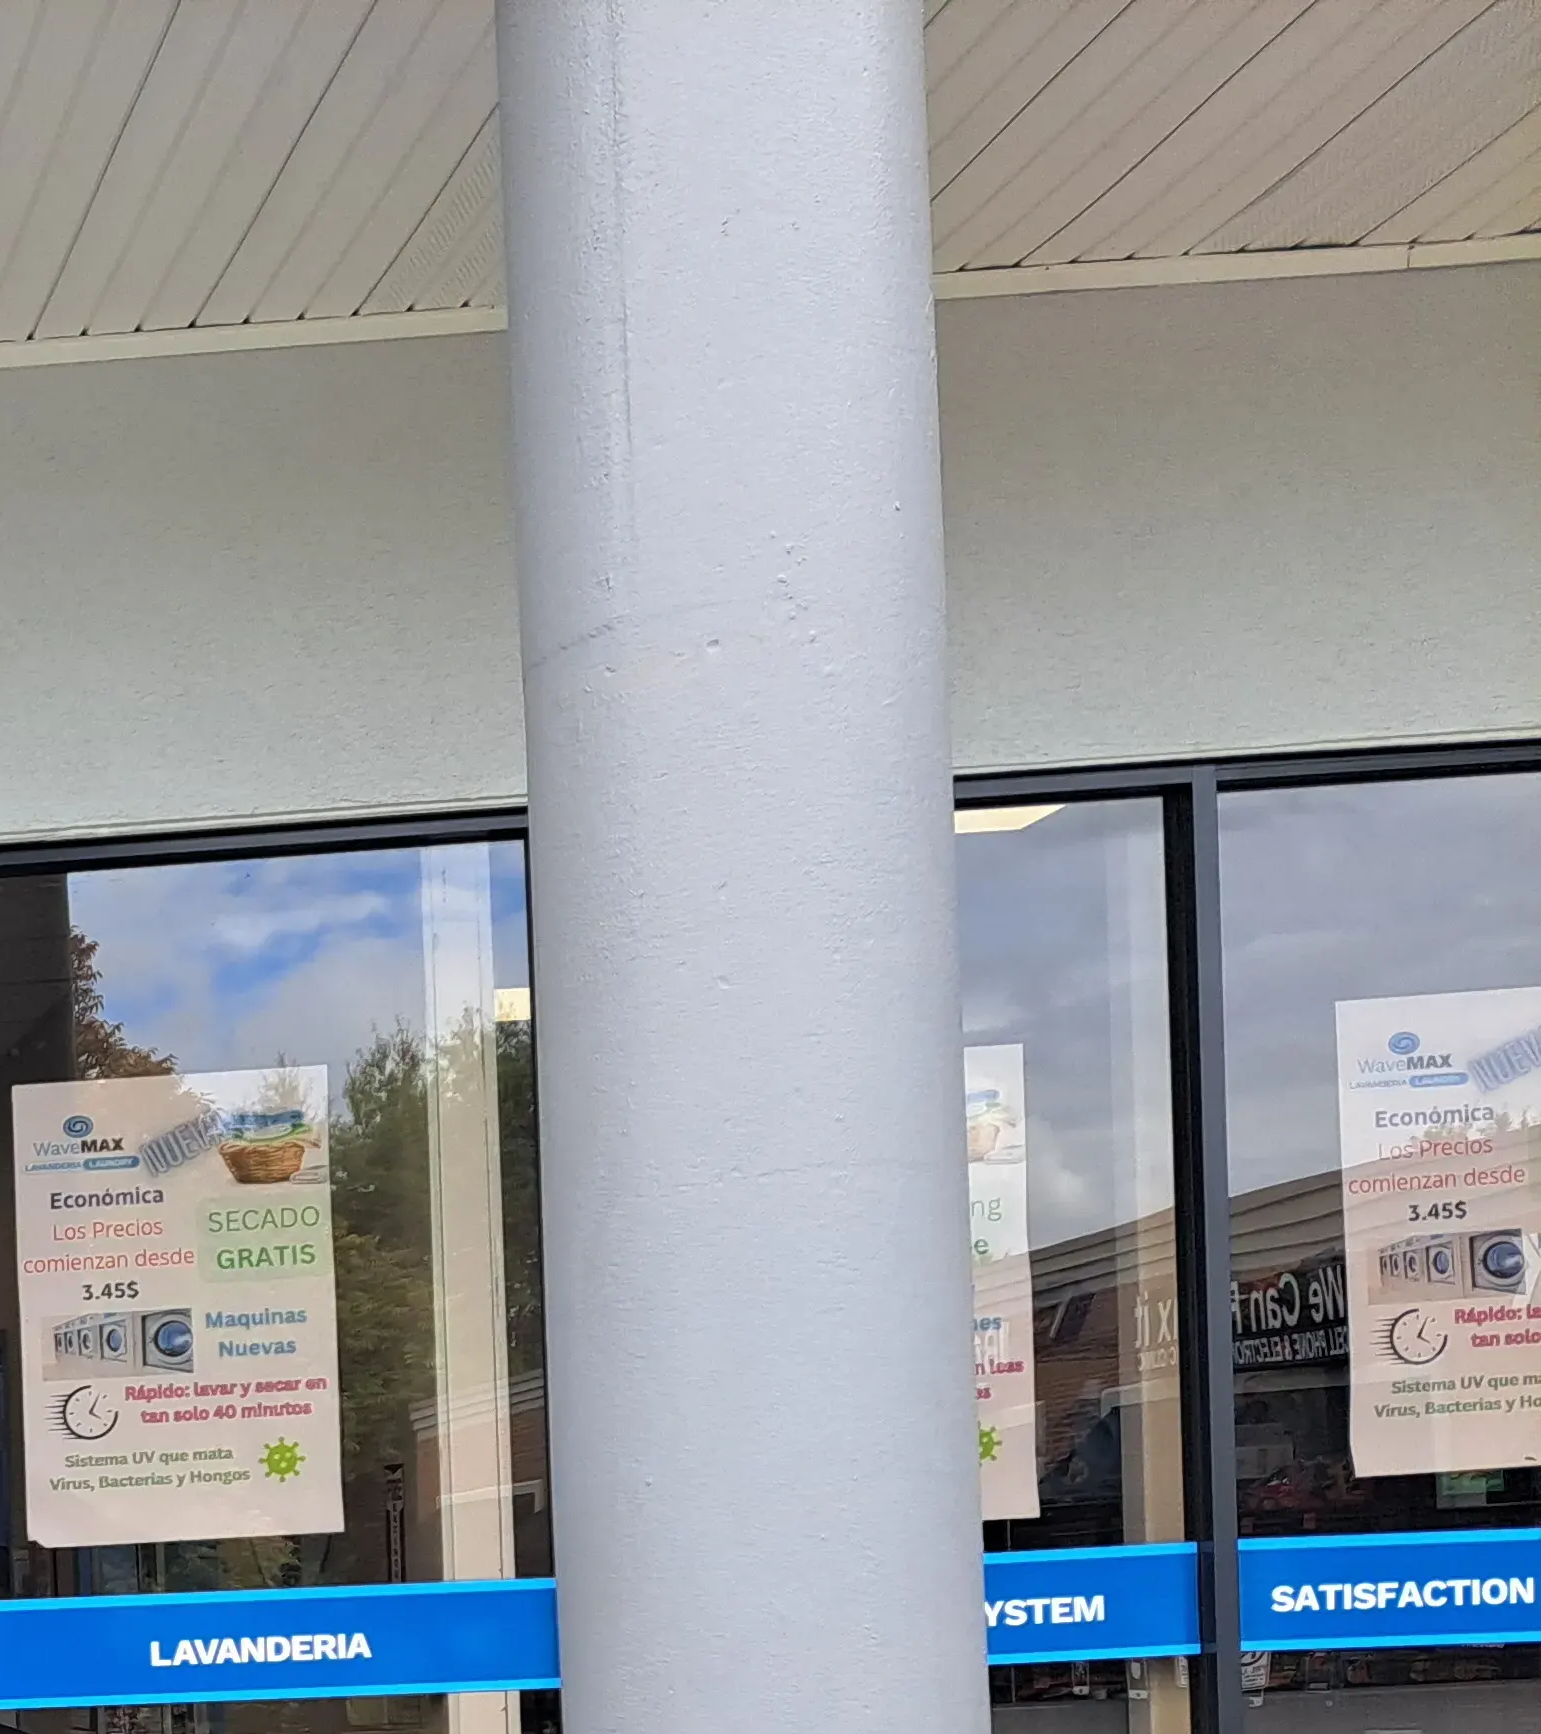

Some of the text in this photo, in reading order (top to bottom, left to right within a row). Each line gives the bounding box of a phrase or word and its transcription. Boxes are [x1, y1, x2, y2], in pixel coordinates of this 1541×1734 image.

[1358, 1053, 1454, 1075] WaveMAX
[1467, 1026, 1541, 1094] NUEV
[1375, 1104, 1494, 1128] Económica
[33, 1137, 125, 1157] WaveMAX
[1378, 1137, 1493, 1160] Los Precios
[1348, 1164, 1526, 1195] comienzan desde
[50, 1186, 164, 1210] Económica
[208, 1205, 320, 1233] SECADO
[1408, 1199, 1468, 1222] 3.45$
[53, 1219, 163, 1242] Los Precios
[23, 1247, 195, 1275] comienzan desde
[216, 1243, 316, 1270] GRATIS
[82, 1280, 140, 1301] 3.45$
[205, 1307, 308, 1330] Maquinas
[1455, 1305, 1522, 1326] Rápido:
[219, 1338, 297, 1358] Nuevas
[1471, 1331, 1500, 1347] tan
[125, 1376, 328, 1403] Rápido: lavar y secar en
[1391, 1377, 1456, 1395] Sistema
[1460, 1374, 1485, 1390] UV
[1487, 1374, 1518, 1391] que
[140, 1400, 313, 1424] tan solo 40 minutos
[1374, 1403, 1421, 1419] Virus,
[1424, 1396, 1502, 1415] Bacterias
[1506, 1398, 1516, 1413] y
[65, 1447, 234, 1469] Sistema UV que mata
[49, 1467, 252, 1493] Virus, Bacterias y Hongos
[1270, 1577, 1536, 1614] SATISFACTION
[984, 1594, 1106, 1629] YSTEM
[150, 1631, 373, 1668] LAVANDERIA
